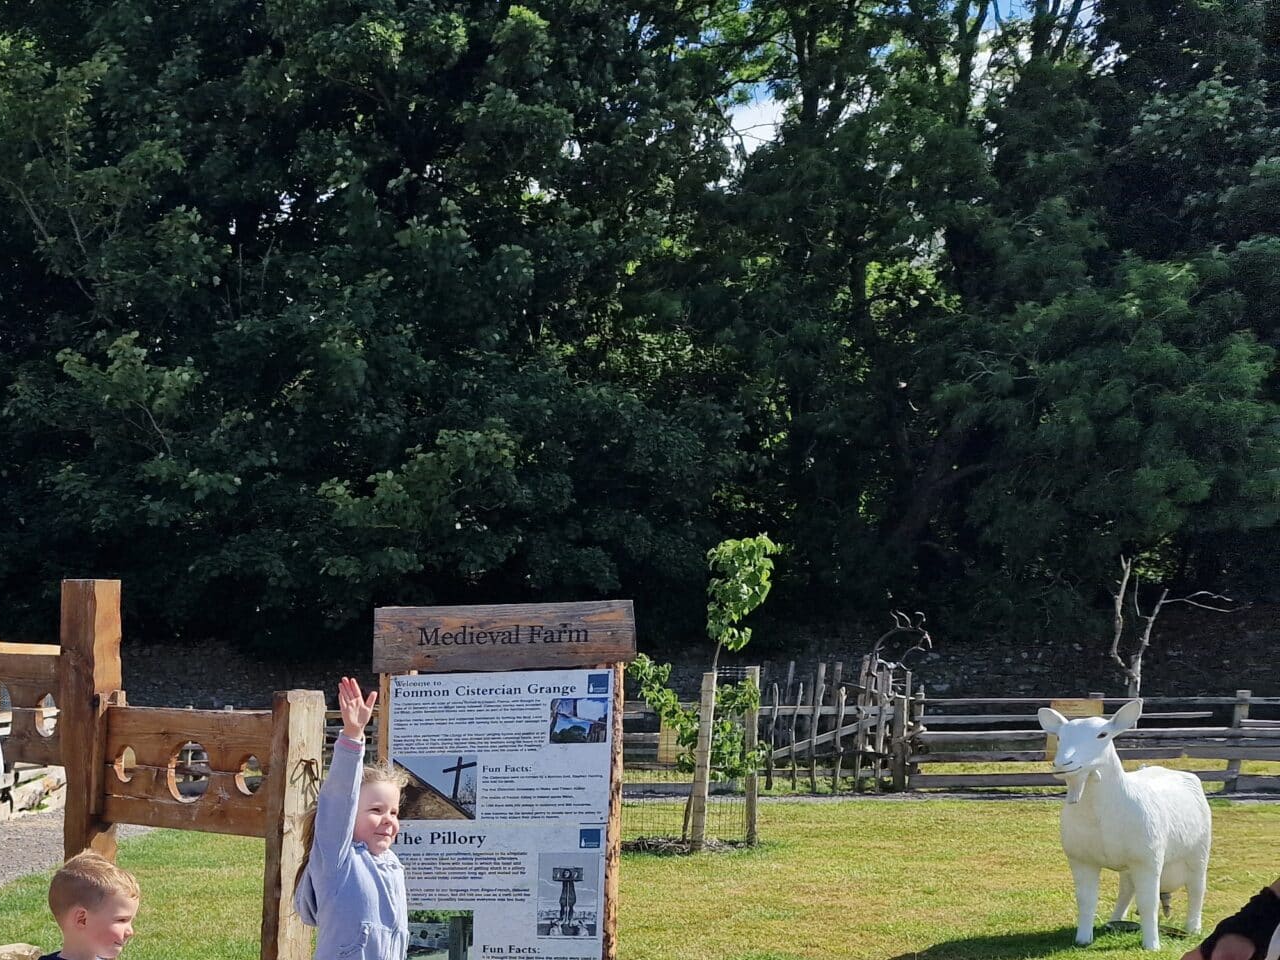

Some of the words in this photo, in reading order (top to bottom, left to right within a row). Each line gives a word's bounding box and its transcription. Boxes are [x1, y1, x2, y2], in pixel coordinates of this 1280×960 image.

[418, 625, 520, 646] Medieval
[528, 623, 588, 644] Farm
[394, 686, 450, 698] Fonmon
[455, 684, 521, 696] Cistercian
[527, 683, 576, 697] Grange
[482, 765, 501, 773] Fun
[504, 764, 532, 773] Facts:
[394, 832, 422, 845] The
[429, 831, 487, 848] Pillory
[482, 944, 504, 954] Fun
[508, 944, 541, 954] Facts:
